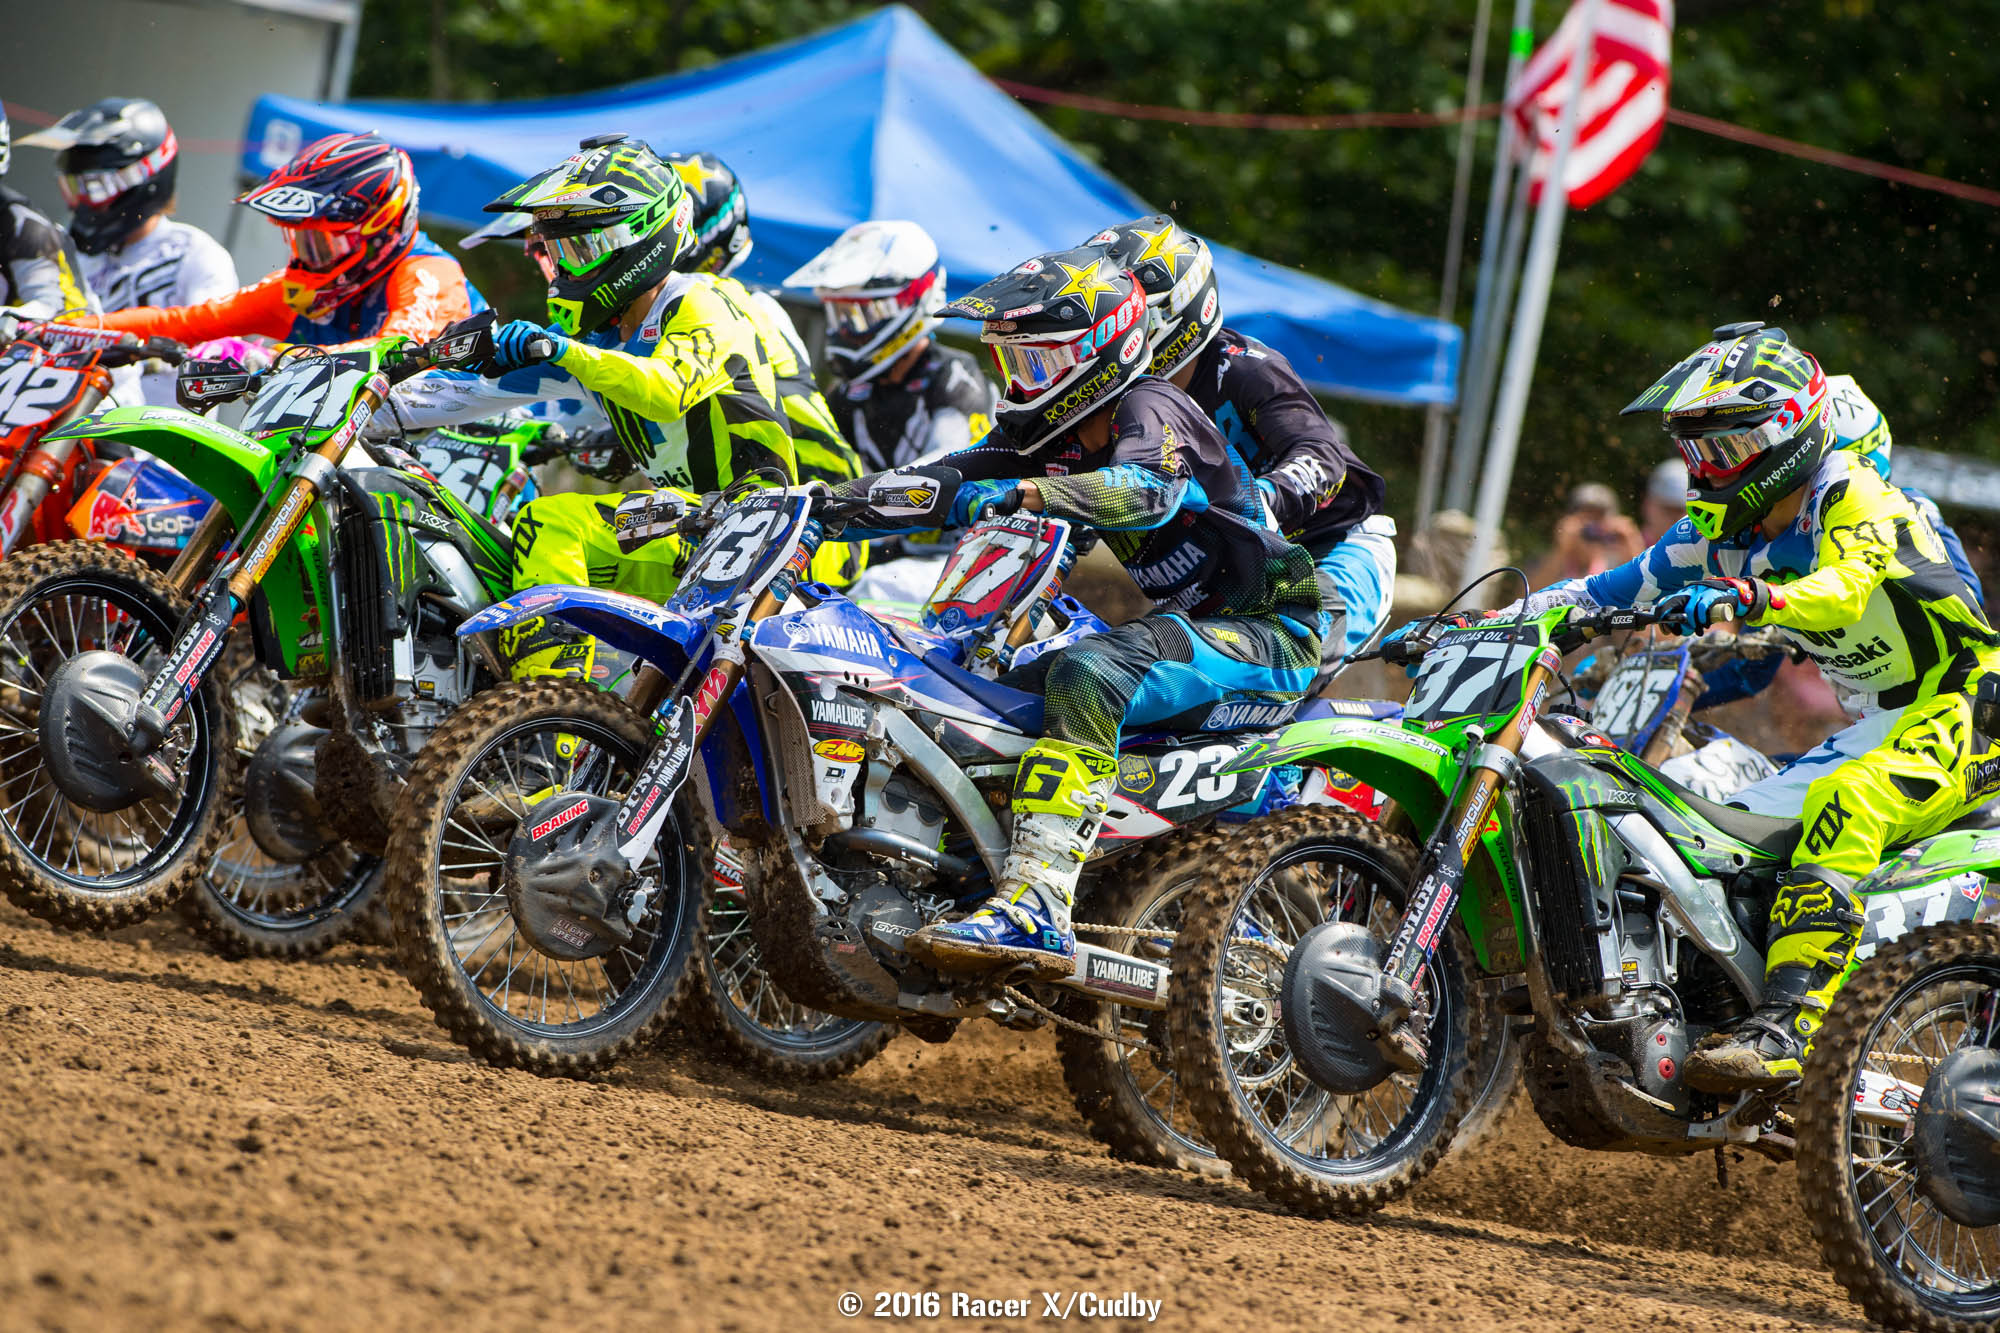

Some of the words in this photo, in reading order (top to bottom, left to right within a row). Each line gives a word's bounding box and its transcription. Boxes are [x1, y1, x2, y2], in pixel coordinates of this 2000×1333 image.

[1004, 306, 1033, 319] FLEX
[1203, 295, 1215, 318] BELL
[1123, 335, 1141, 359] BELL
[1056, 400, 1091, 425] ENERGY
[1093, 377, 1122, 400] DRINK
[244, 545, 269, 574] PRO
[265, 485, 302, 544] CIRCUIT
[419, 510, 451, 534] KX
[512, 505, 545, 576] FOX
[1011, 519, 1031, 531] OIL
[930, 529, 1051, 605] 17
[1128, 541, 1207, 589] YAMAHA
[808, 623, 883, 659] YAMAHA
[1211, 627, 1240, 643] THOR
[1450, 631, 1484, 645] LUCAS
[1484, 631, 1504, 641] OIL
[1611, 615, 1634, 625] ARC
[142, 621, 201, 706] DUNLOP
[176, 629, 216, 686] BRAKING
[1402, 639, 1539, 720] 37
[810, 699, 867, 729] YAMALUBE
[654, 741, 690, 788] YAMALUBE
[1156, 744, 1239, 811] 23
[628, 786, 662, 836] BRAKING
[1455, 781, 1490, 849] CIRCUIT
[1608, 790, 1637, 805] KX
[531, 800, 589, 841] BRAKING
[1805, 790, 1853, 857] FOX
[550, 926, 585, 948] SPEED
[1416, 882, 1452, 950] BRAKING
[1092, 958, 1158, 991] YAMALUBE
